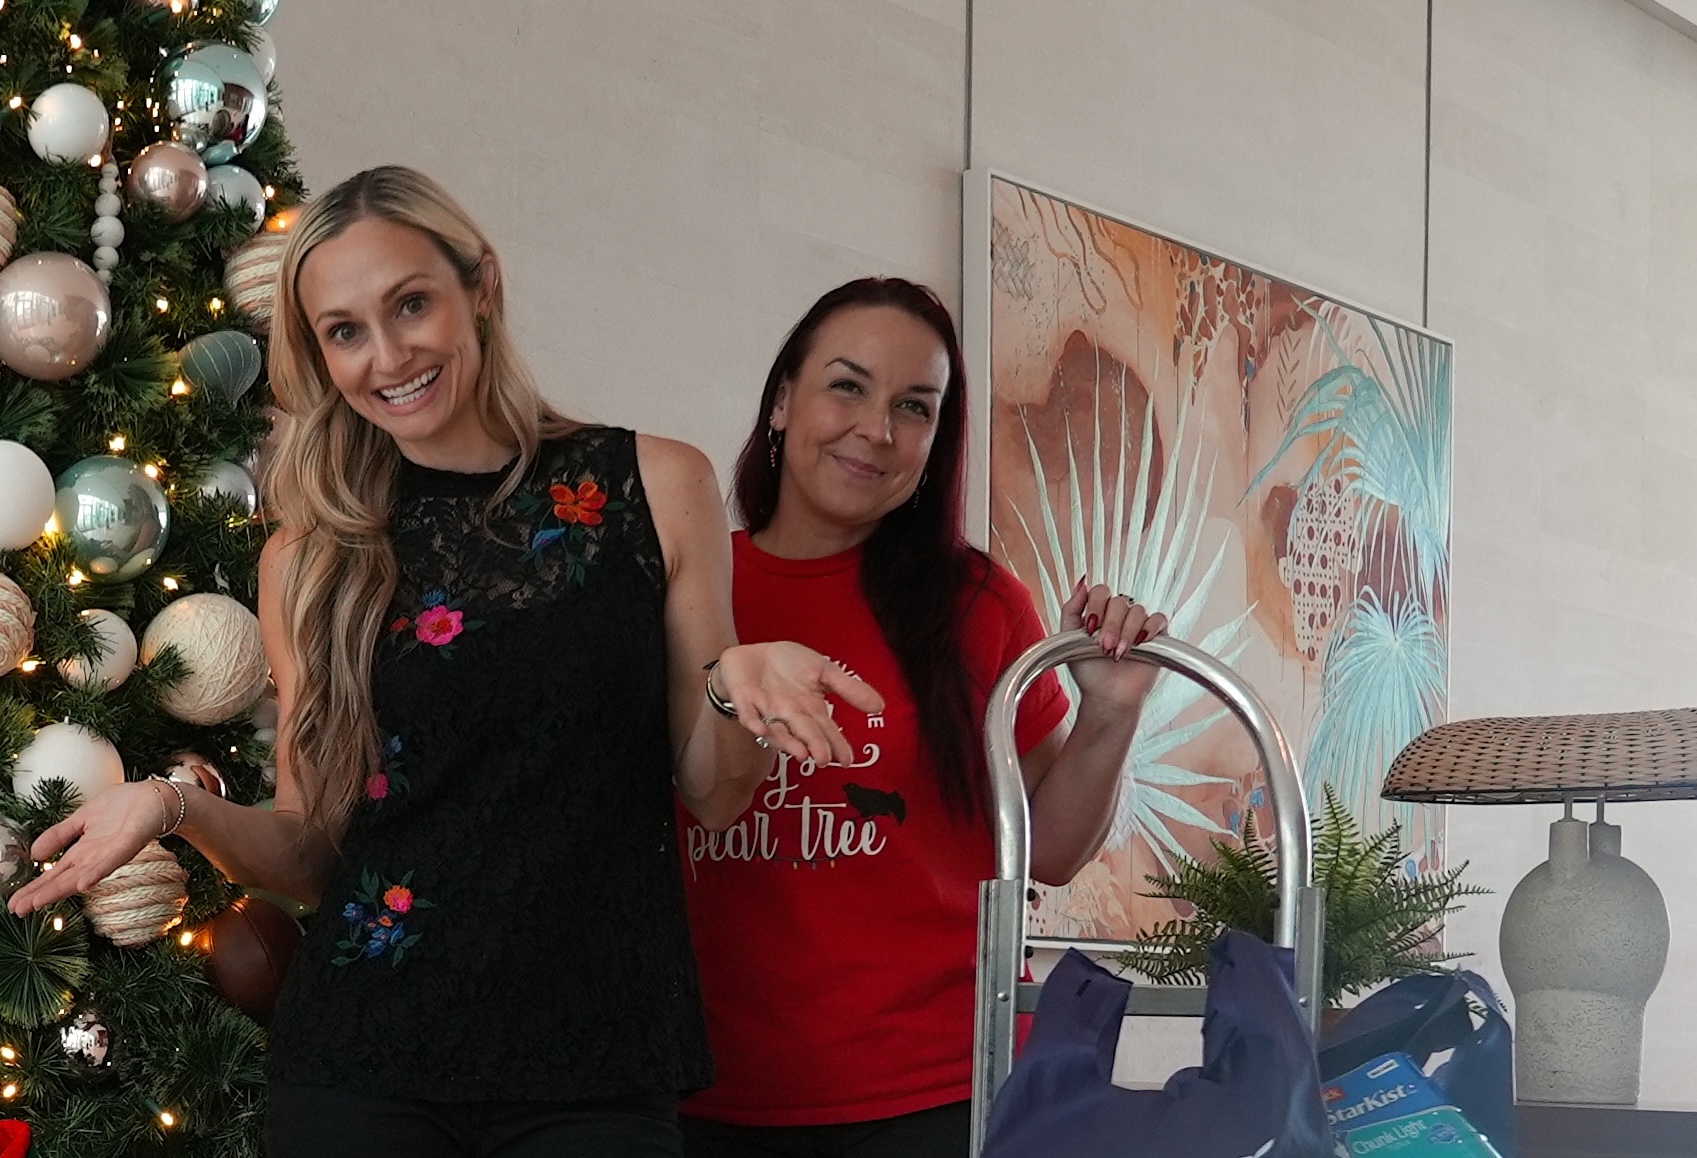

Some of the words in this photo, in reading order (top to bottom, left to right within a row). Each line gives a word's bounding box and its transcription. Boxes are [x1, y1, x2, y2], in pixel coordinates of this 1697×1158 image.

[687, 811, 779, 882] pear
[784, 795, 887, 861] tree
[1325, 1084, 1408, 1126] StarKist
[1353, 1129, 1398, 1155] Chunk
[1394, 1118, 1428, 1142] Light
